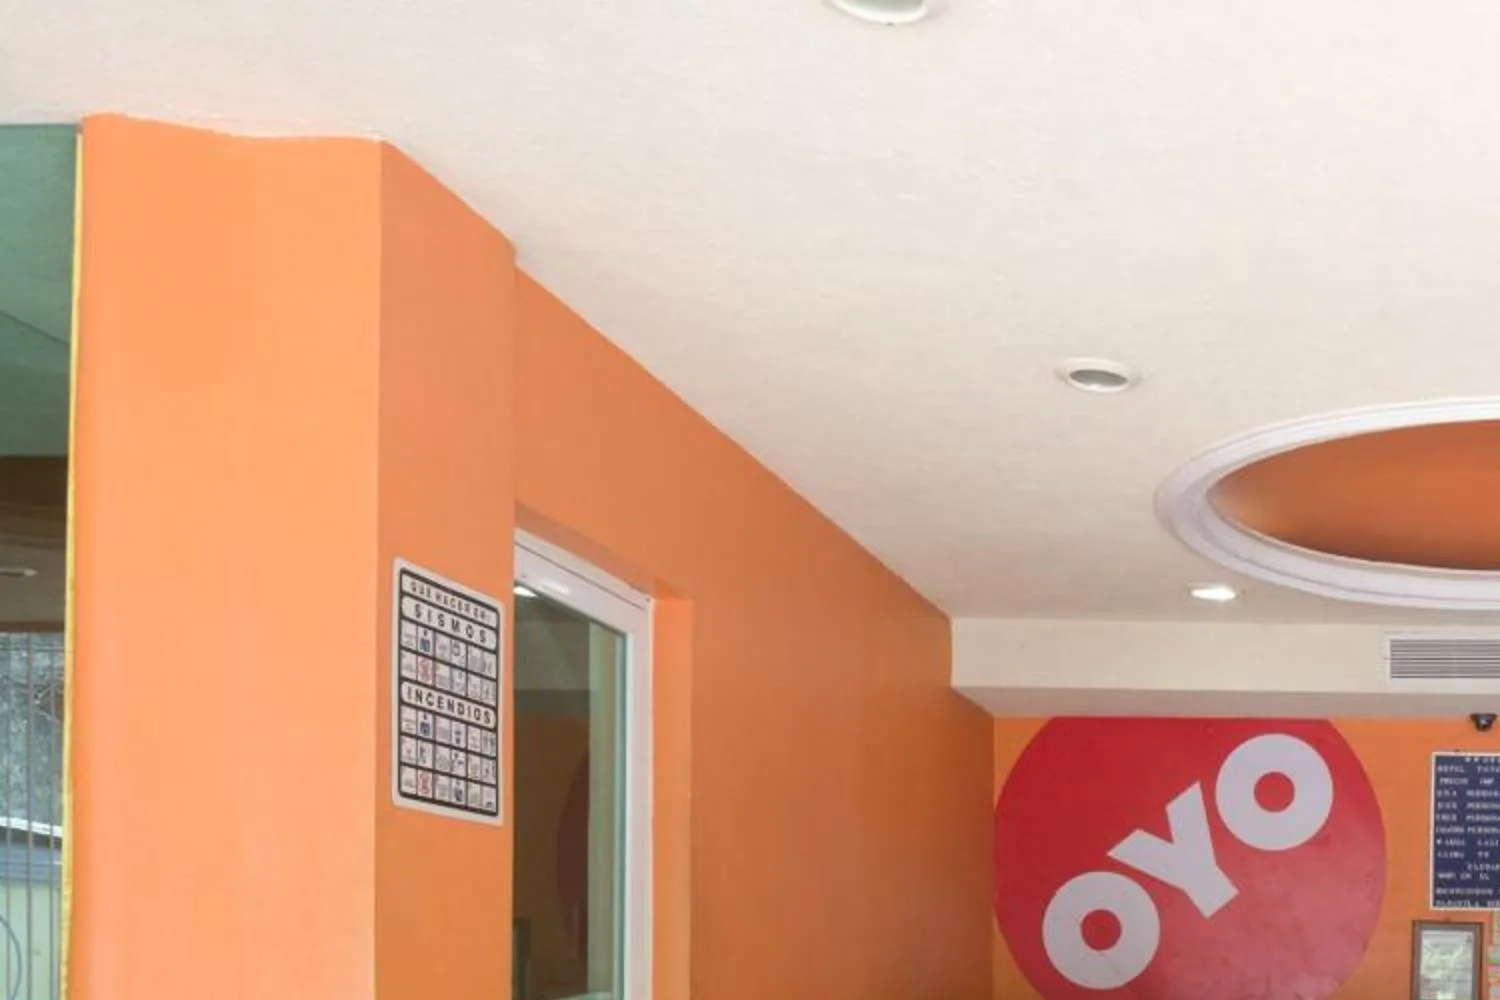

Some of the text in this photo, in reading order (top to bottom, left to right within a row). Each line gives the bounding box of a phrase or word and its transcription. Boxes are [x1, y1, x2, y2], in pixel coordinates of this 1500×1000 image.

[414, 603, 487, 643] SISMOS
[407, 685, 491, 724] INCENDIOS
[1042, 733, 1334, 990] OYO
